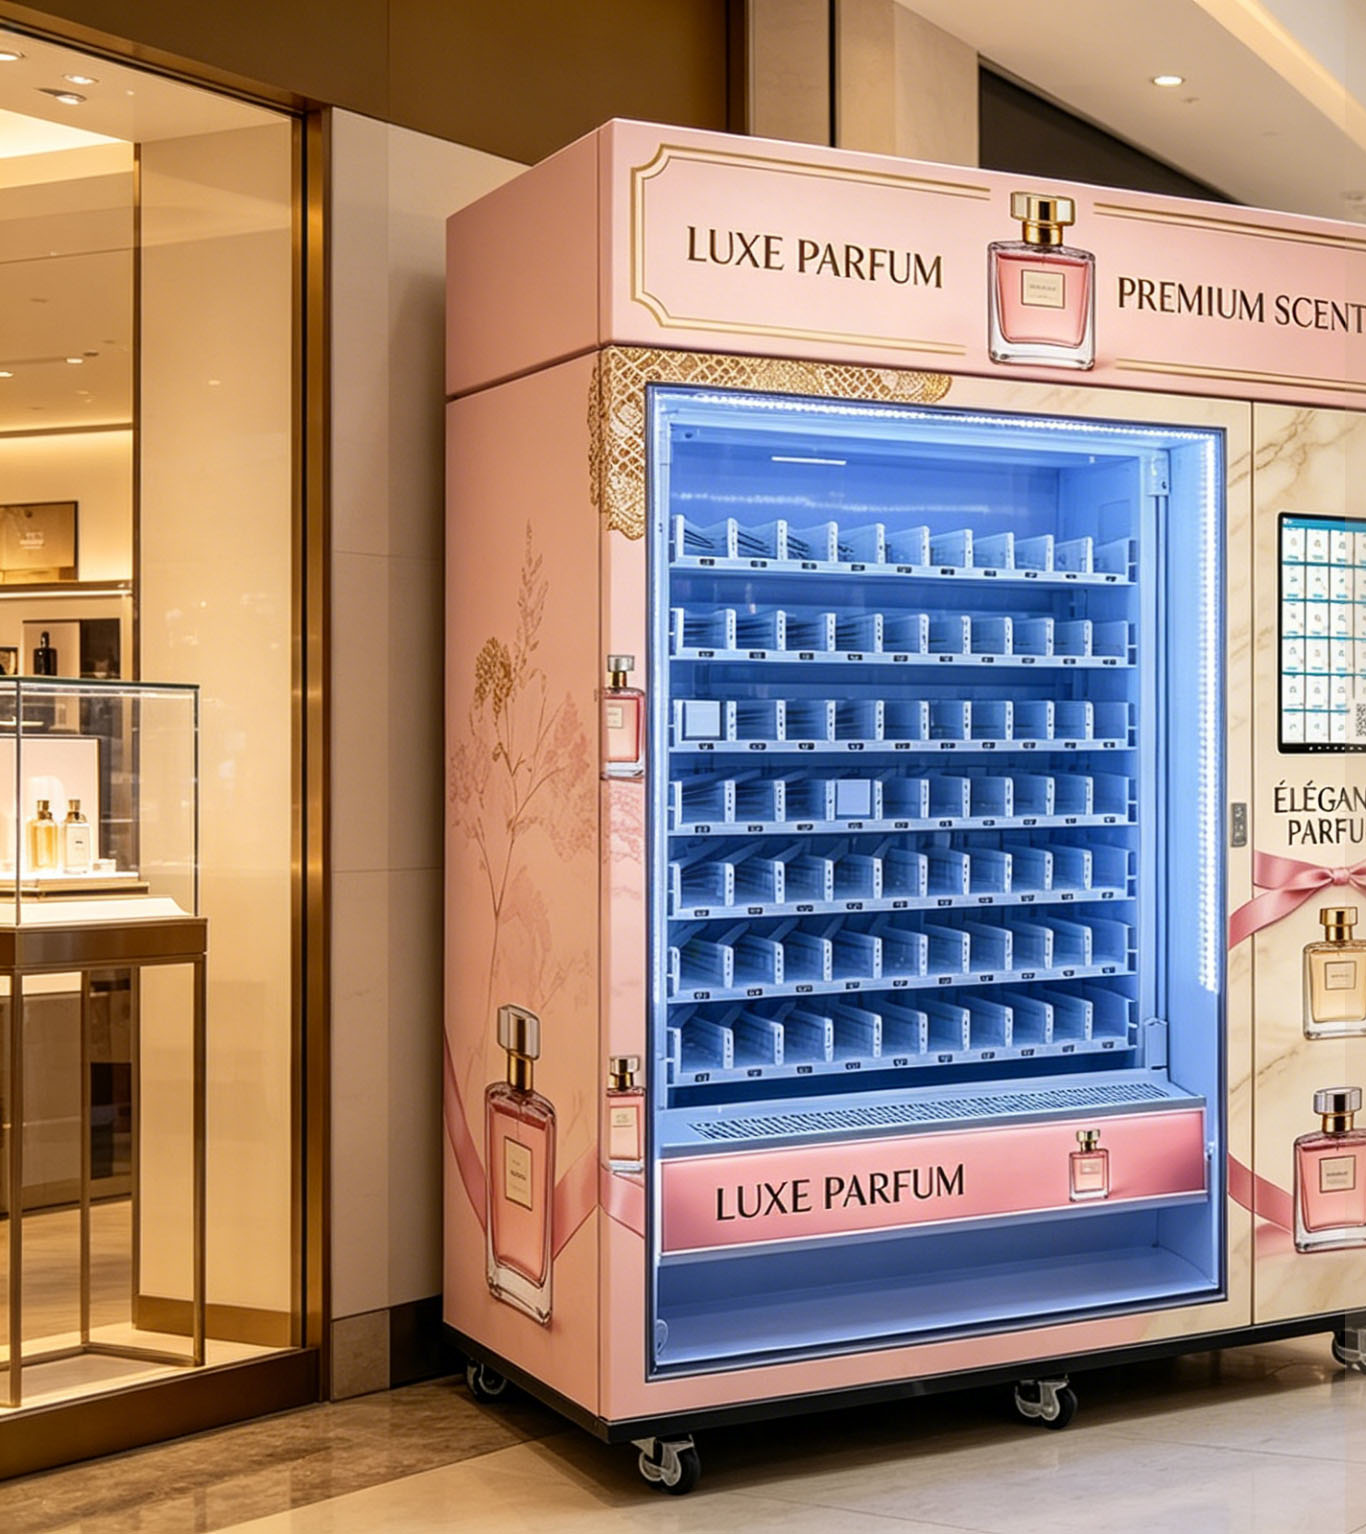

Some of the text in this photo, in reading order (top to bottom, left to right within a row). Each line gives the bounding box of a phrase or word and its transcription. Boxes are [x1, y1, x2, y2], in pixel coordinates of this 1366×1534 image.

[687, 225, 942, 289] LUXE PARFUM
[1117, 276, 1266, 324] PREMIUM
[715, 1163, 964, 1221] LUXE PARFUM
